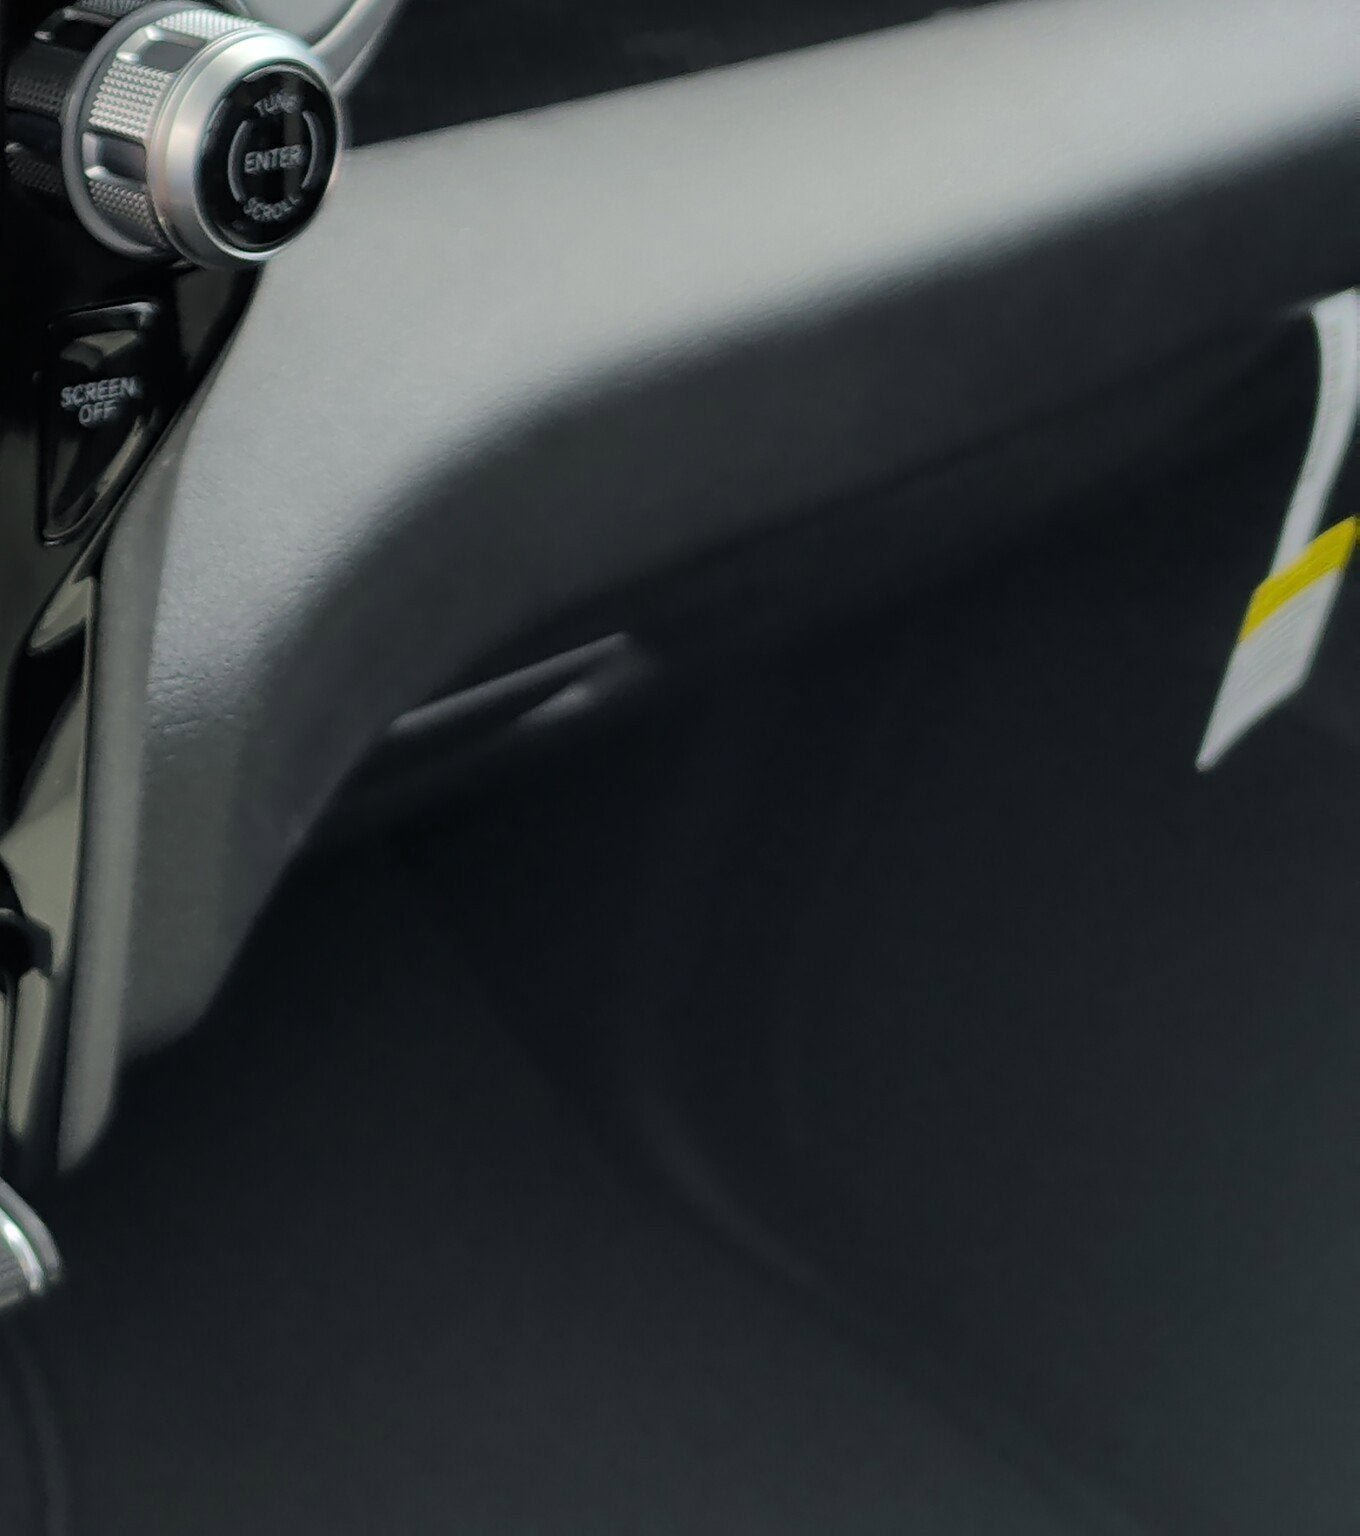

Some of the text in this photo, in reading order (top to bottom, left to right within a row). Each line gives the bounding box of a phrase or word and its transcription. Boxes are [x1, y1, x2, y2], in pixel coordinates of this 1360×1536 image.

[244, 144, 305, 175] ENTER
[60, 376, 140, 408] SCREEN
[78, 400, 118, 426] OFF
